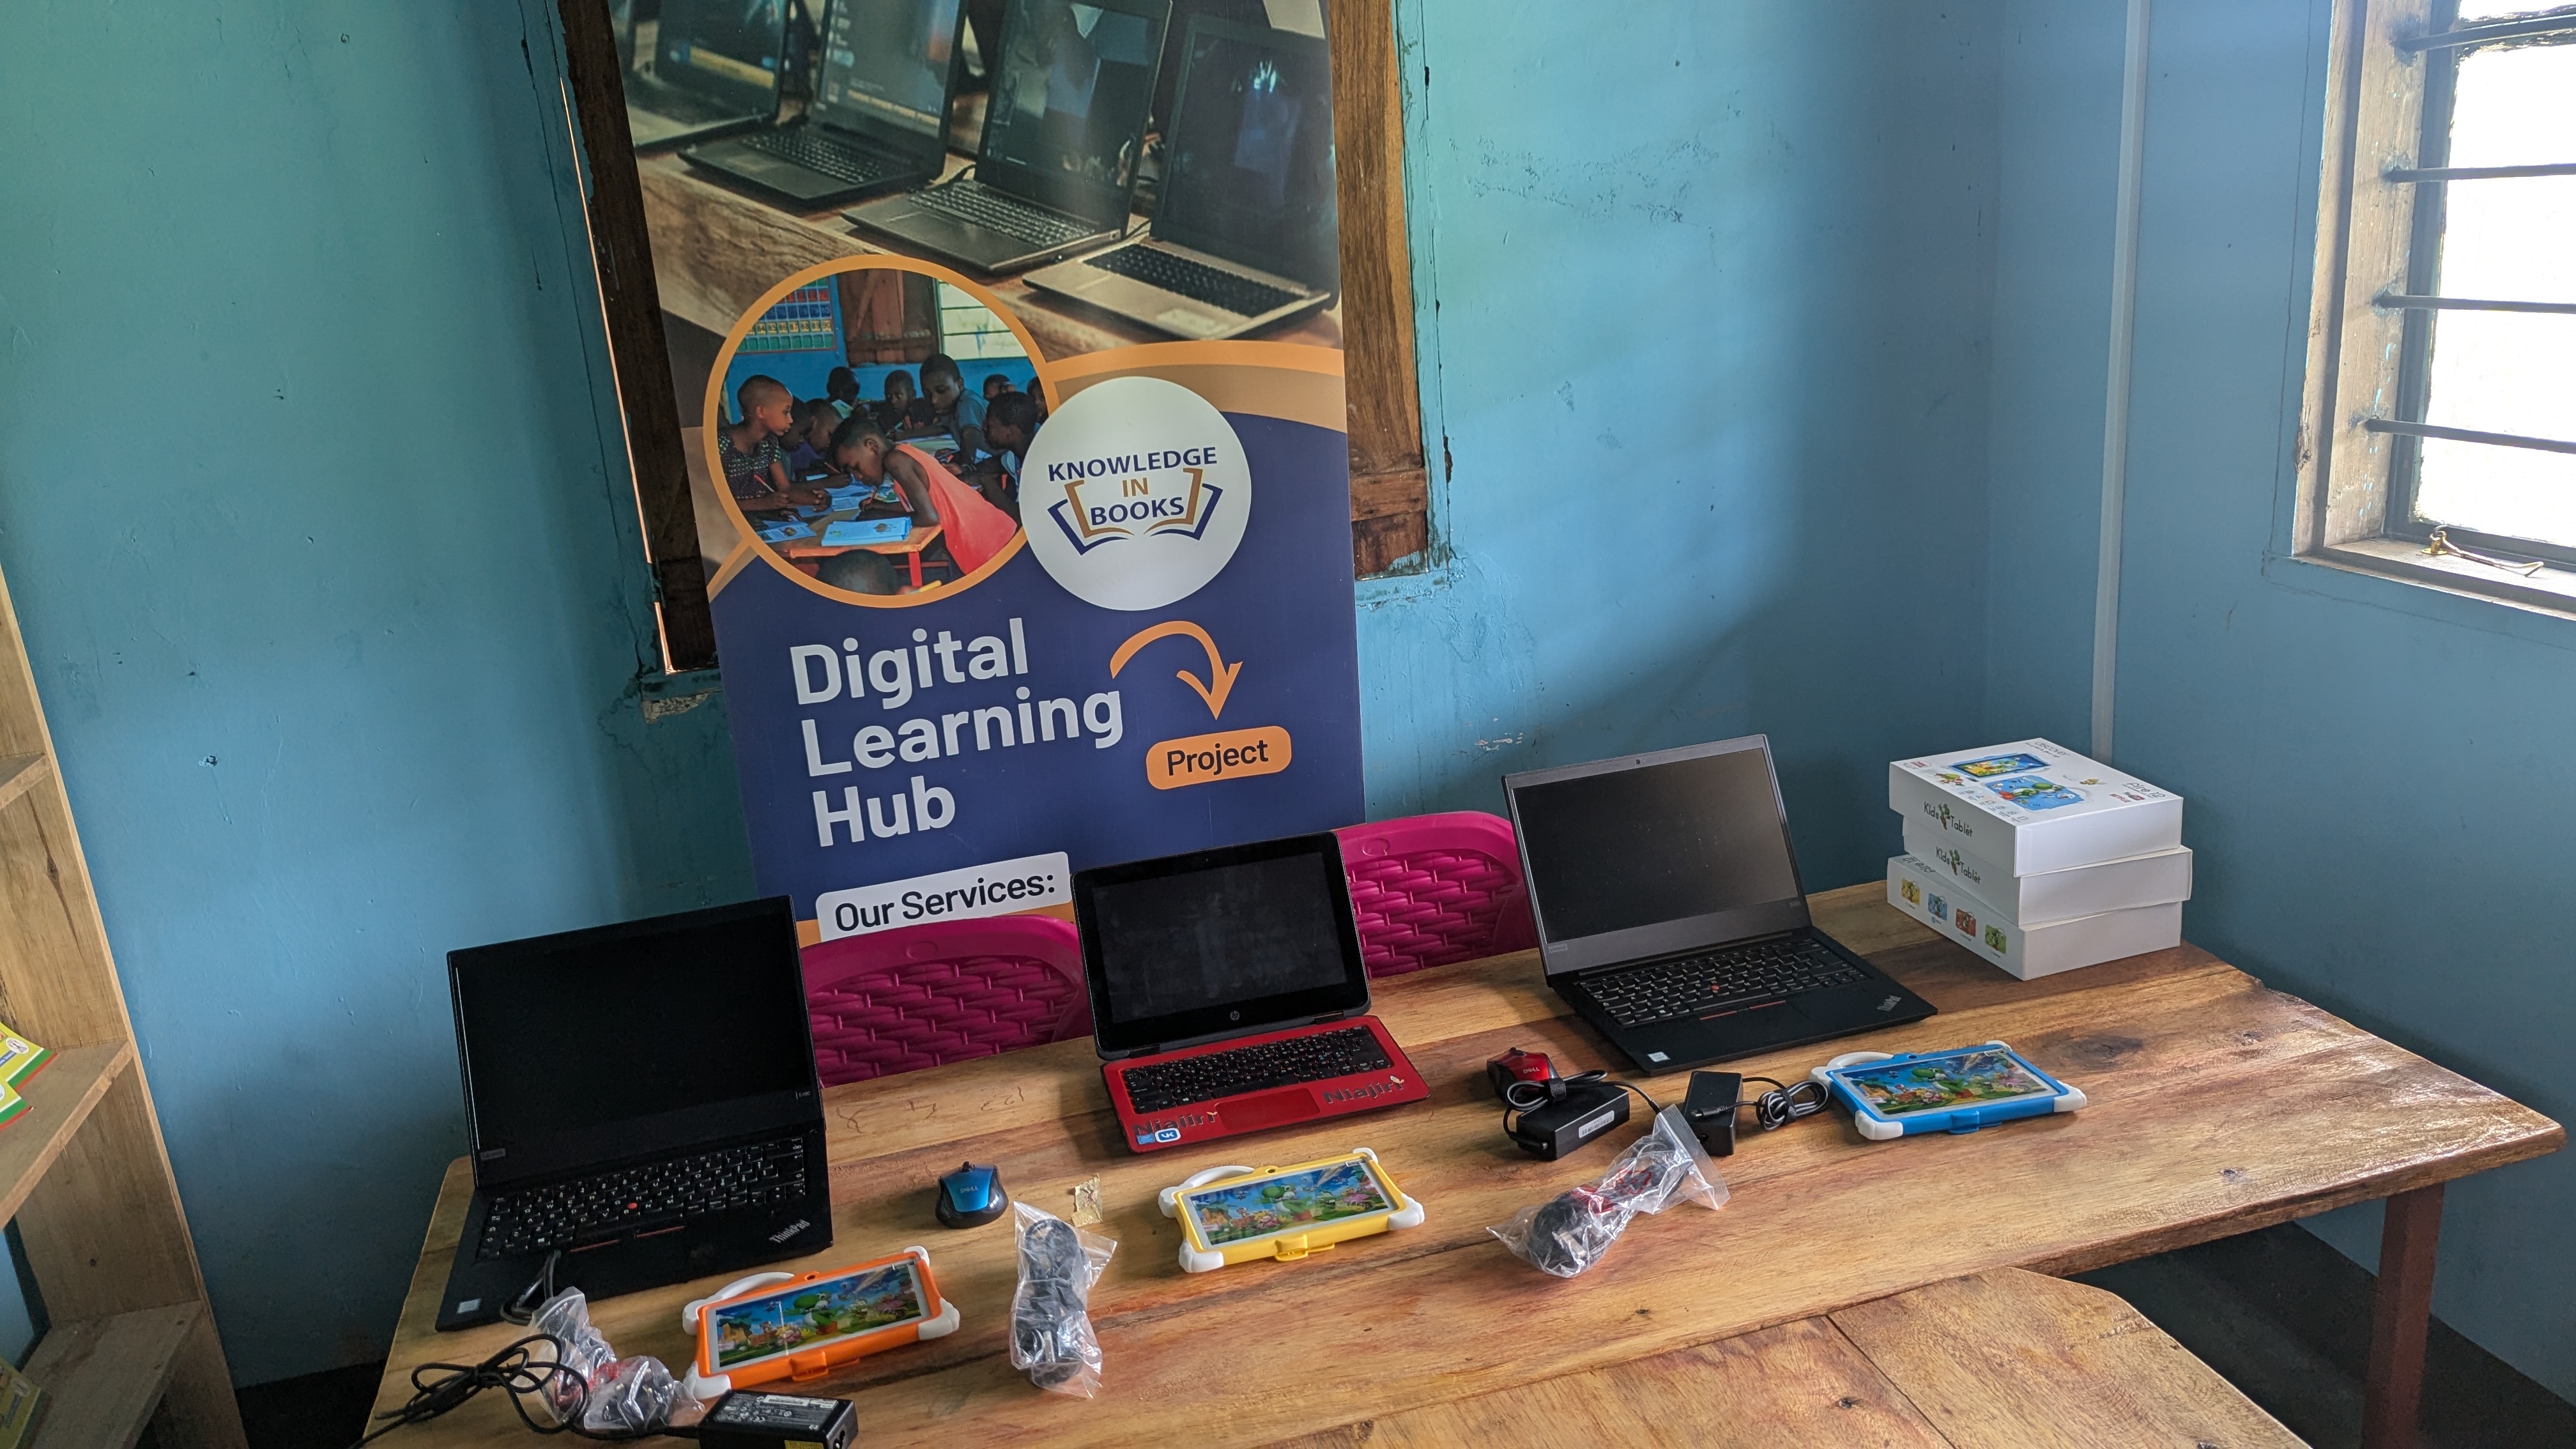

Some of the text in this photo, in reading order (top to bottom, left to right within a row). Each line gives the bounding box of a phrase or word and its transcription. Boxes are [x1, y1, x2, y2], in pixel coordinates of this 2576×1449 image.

[1048, 447, 1217, 481] KNOWLEDGE
[1122, 477, 1149, 497] IN
[1090, 496, 1184, 526] BOOKS
[789, 617, 1029, 710] Digital
[801, 686, 1124, 776] Learning
[1167, 739, 1269, 776] Project
[812, 775, 956, 847] Hub
[1924, 802, 1973, 838] Kids Tablet
[1936, 847, 1981, 884] Kids Tablet
[835, 873, 1055, 932] Our Services:
[960, 1185, 979, 1193] DELL
[768, 1218, 811, 1244] ThinkPad
